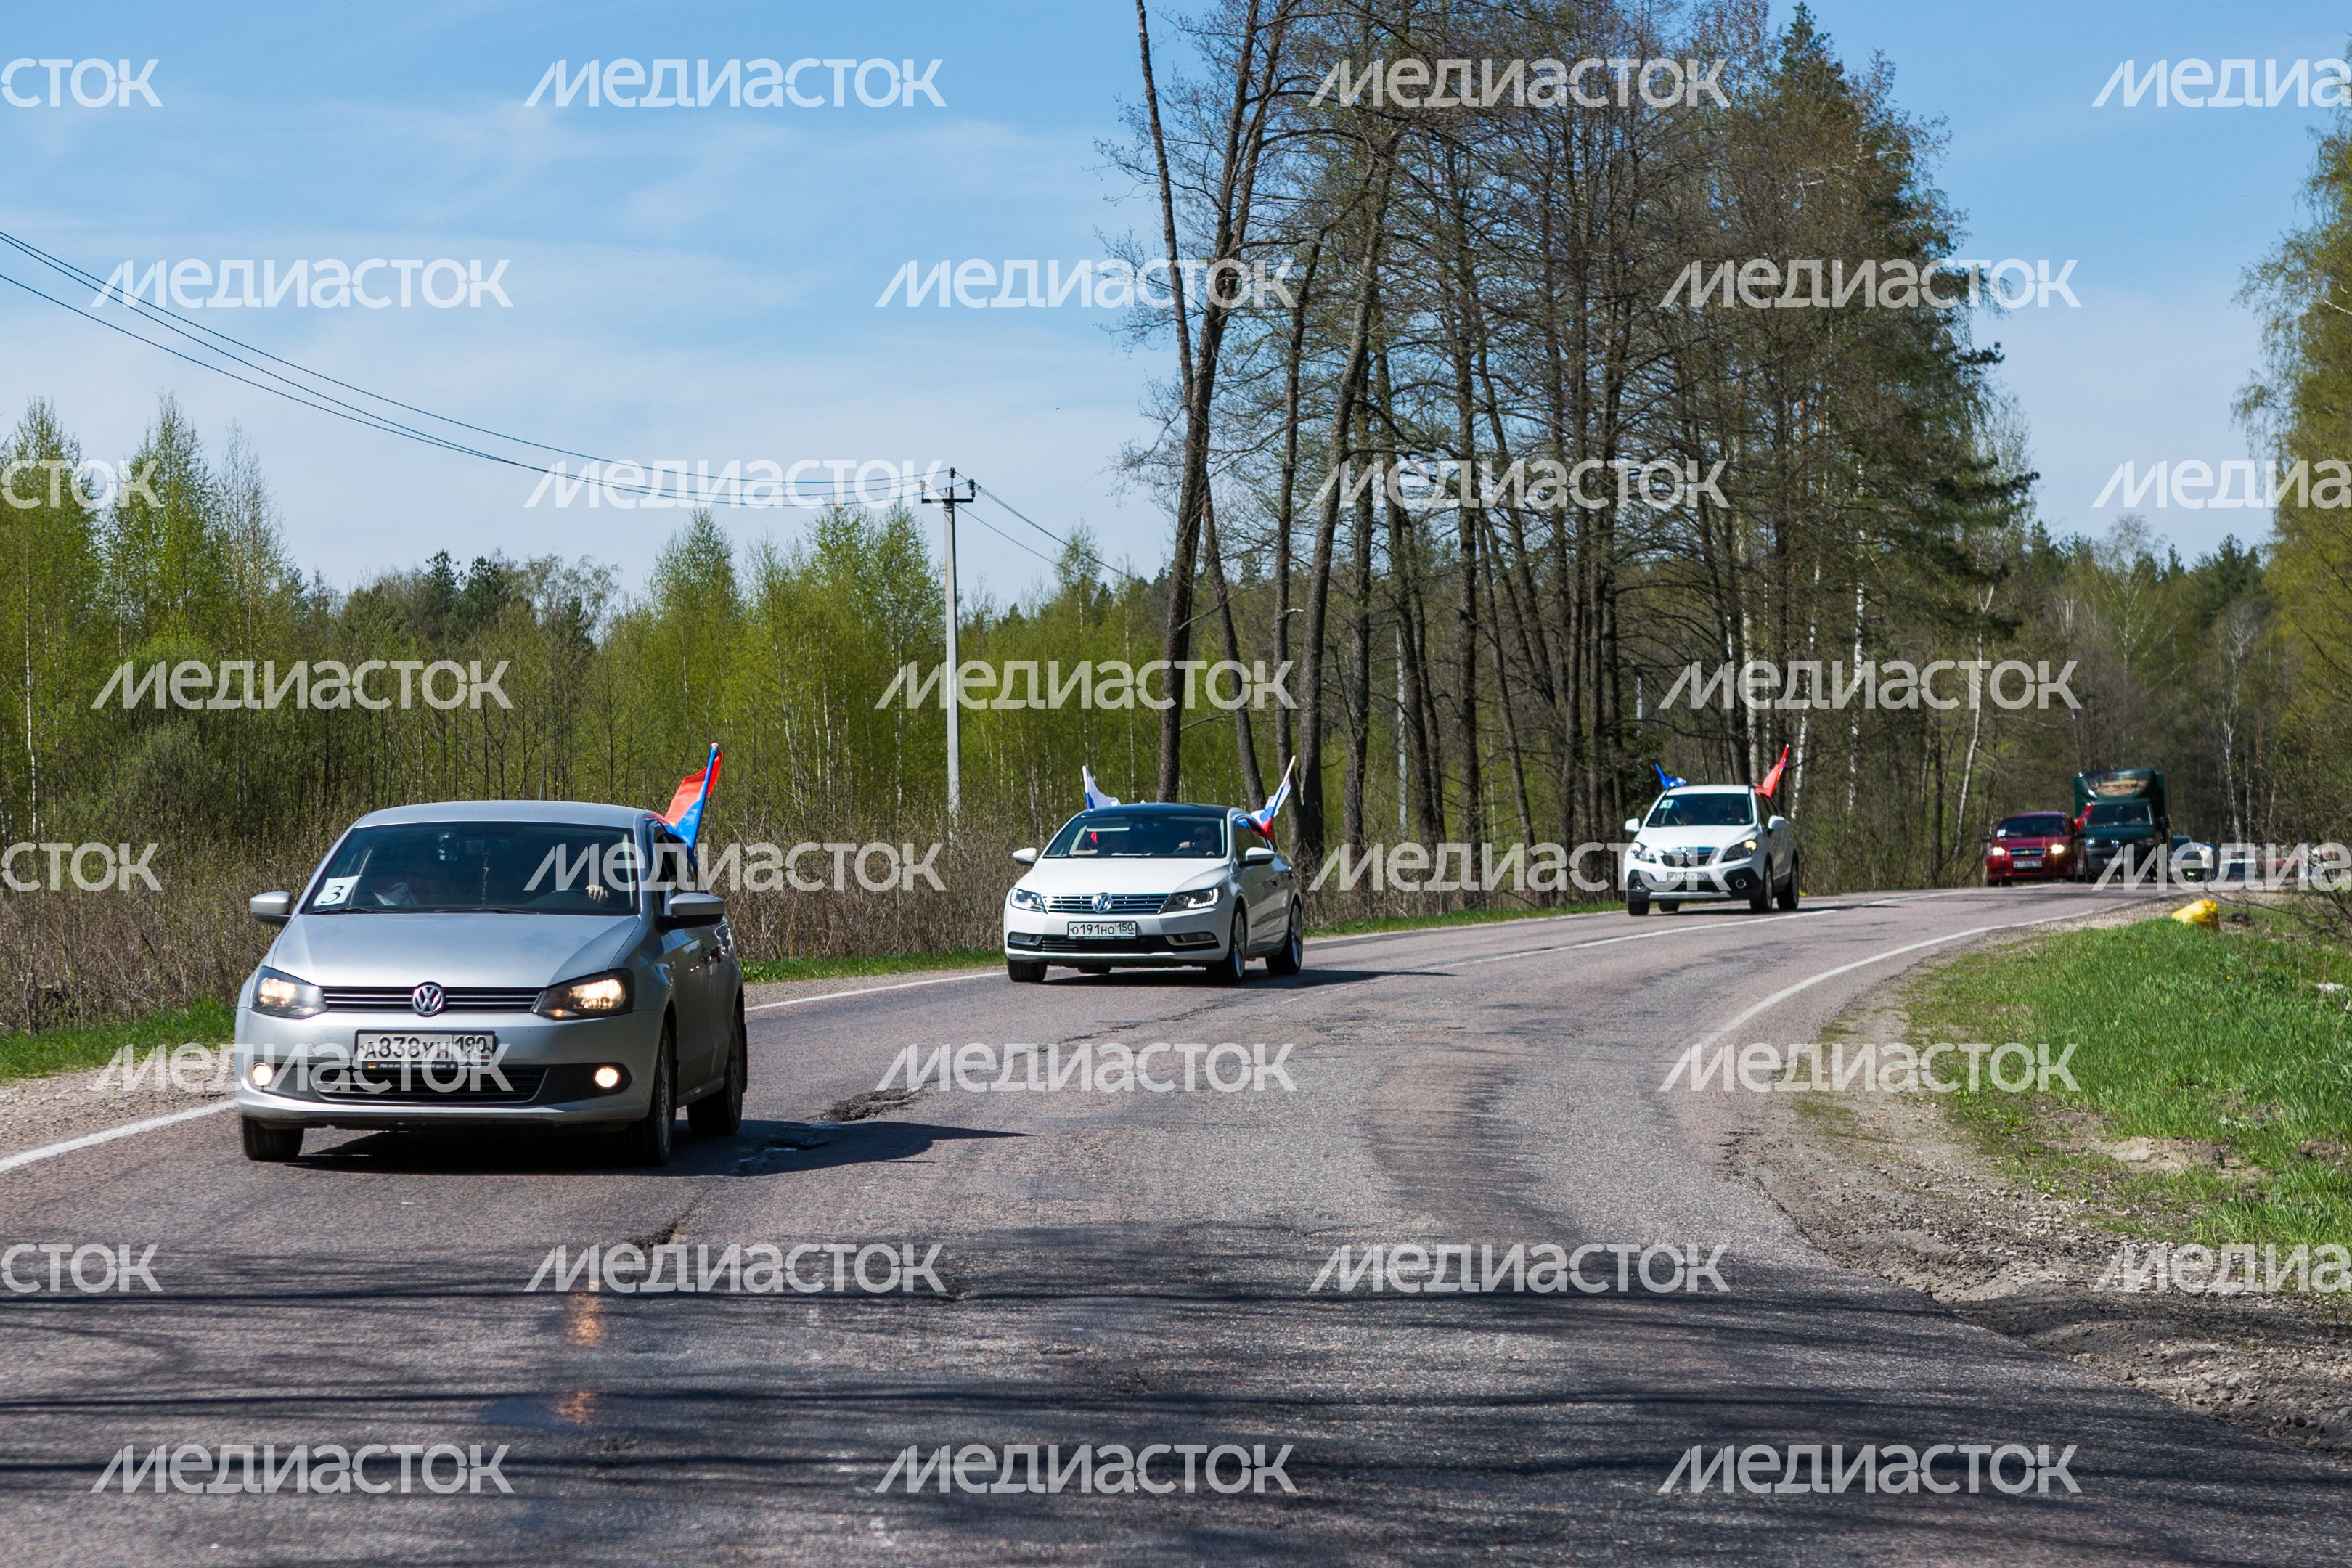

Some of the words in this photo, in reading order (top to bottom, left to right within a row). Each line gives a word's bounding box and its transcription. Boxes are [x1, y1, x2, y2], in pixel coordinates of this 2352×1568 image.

[320, 885, 344, 903] 3
[1117, 923, 1133, 931] 150
[454, 1036, 487, 1053] 190
